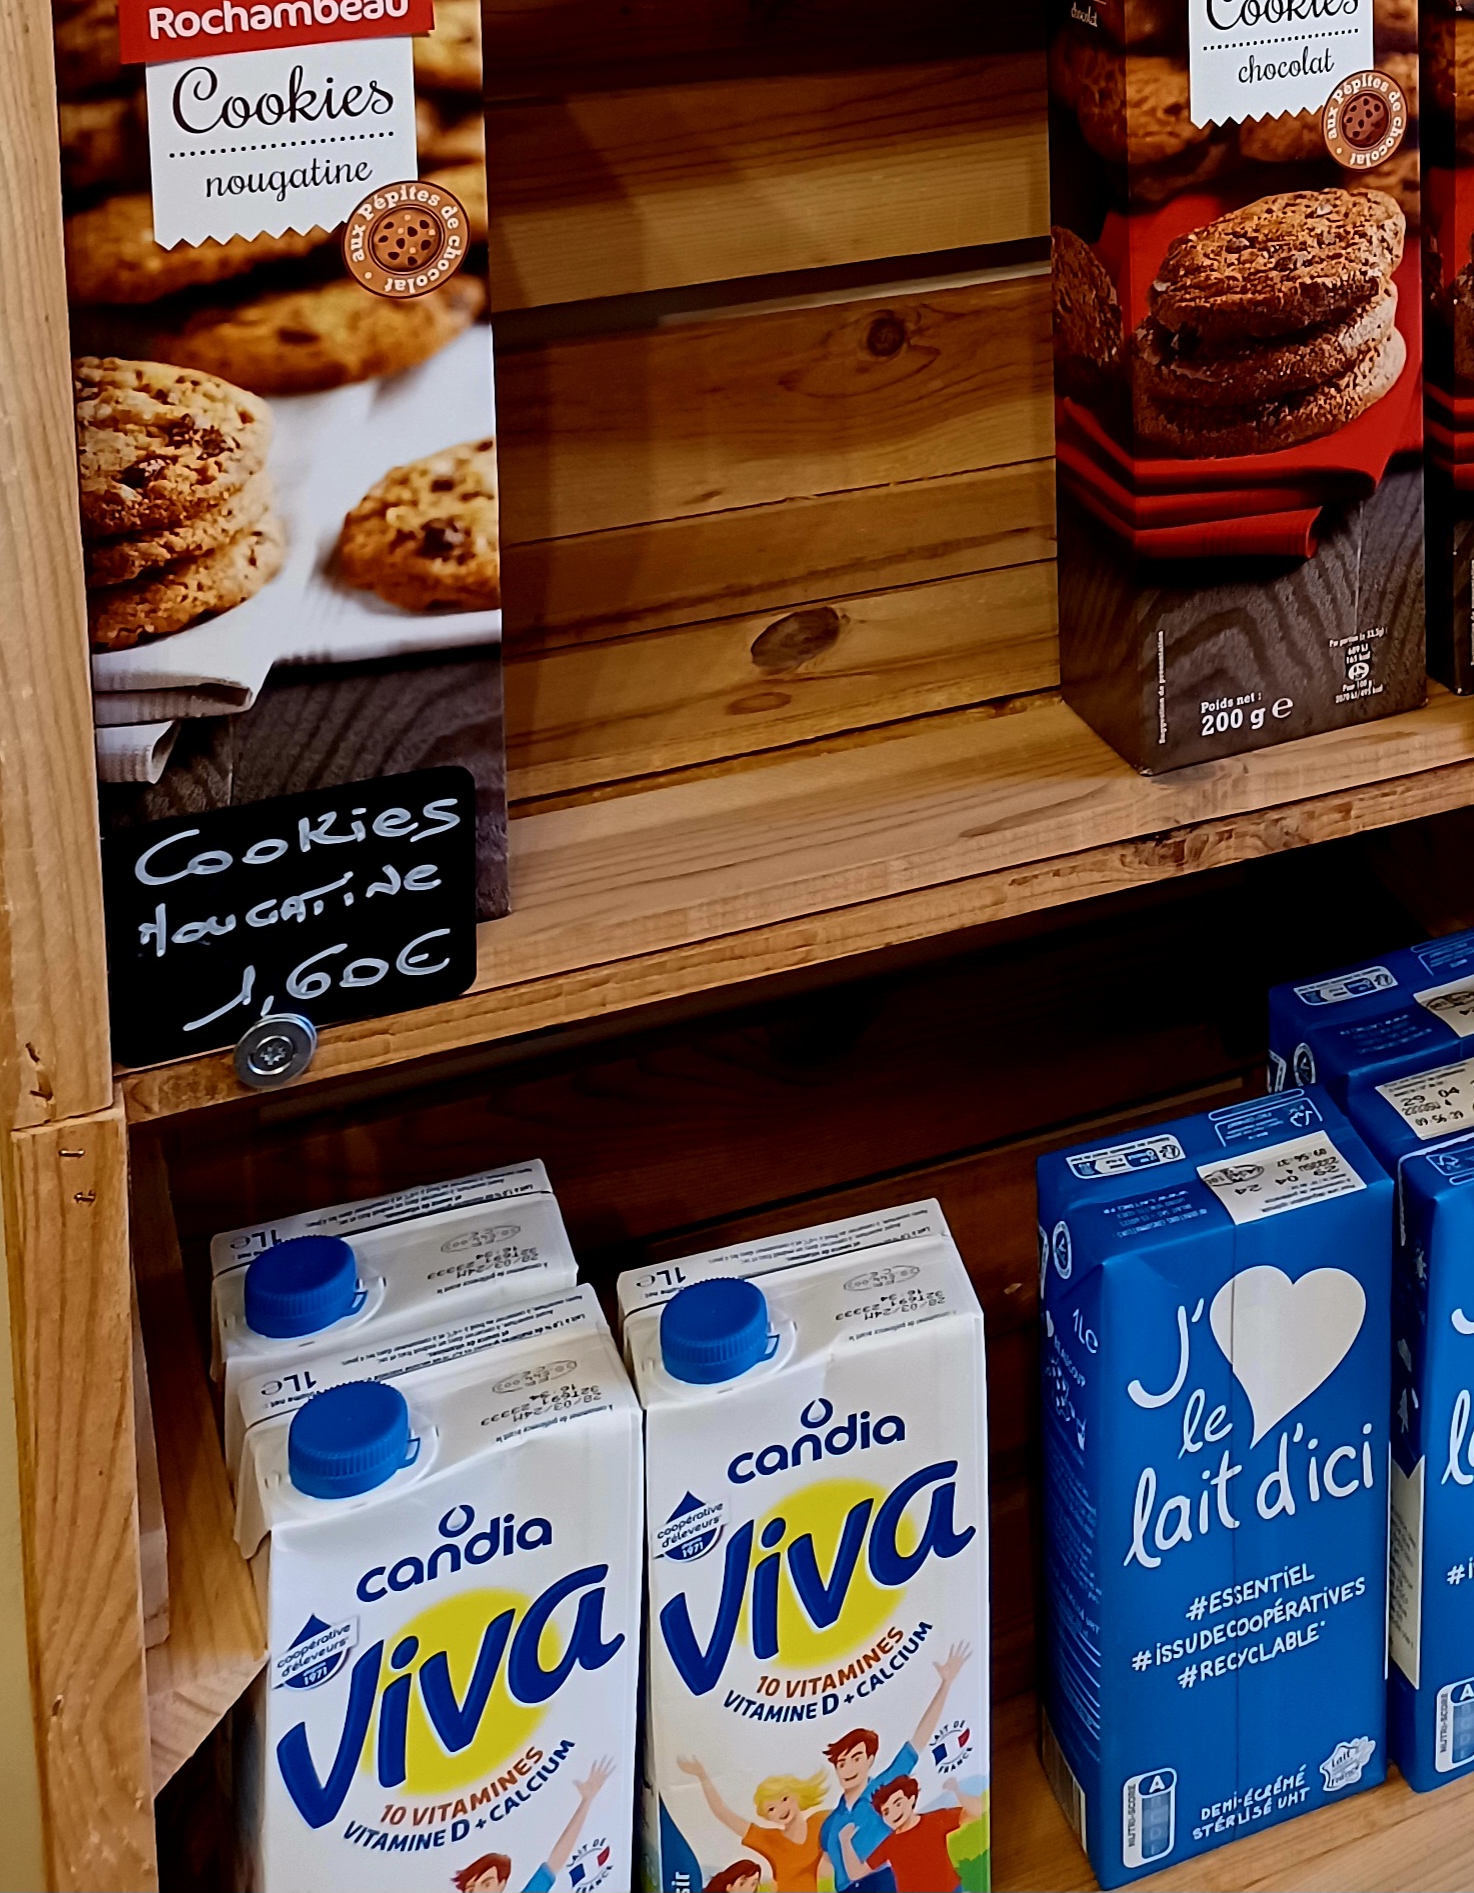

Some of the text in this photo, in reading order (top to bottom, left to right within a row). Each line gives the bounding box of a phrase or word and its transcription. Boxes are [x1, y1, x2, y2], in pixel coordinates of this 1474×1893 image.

[171, 64, 395, 135] Cookies
[1237, 46, 1335, 85] chocolat
[204, 157, 375, 203] nougatine
[357, 184, 442, 221] Pépites
[1200, 692, 1256, 714] Poids net
[1200, 707, 1244, 737] 200
[134, 797, 462, 887] Cookies
[726, 1410, 907, 1485] candia
[1177, 1388, 1234, 1460] le
[655, 1500, 725, 1542] coopérative
[1123, 1422, 1375, 1569] lait d'ici
[355, 1511, 554, 1604] candia
[659, 1459, 977, 1698] Viva
[679, 1540, 706, 1560] 1971
[275, 1621, 353, 1669] coopérative
[303, 1665, 329, 1688] 1971
[722, 1620, 934, 1724] VITAMINE D CALCIUM
[755, 1624, 905, 1700] 10 VITAMINES
[275, 1562, 627, 1830] Viva
[1459, 1682, 1474, 1701] A
[342, 1737, 577, 1853] VITAMINE D CALCIUM
[379, 1744, 545, 1828] 10 VITAMINES
[1148, 1774, 1165, 1794] A
